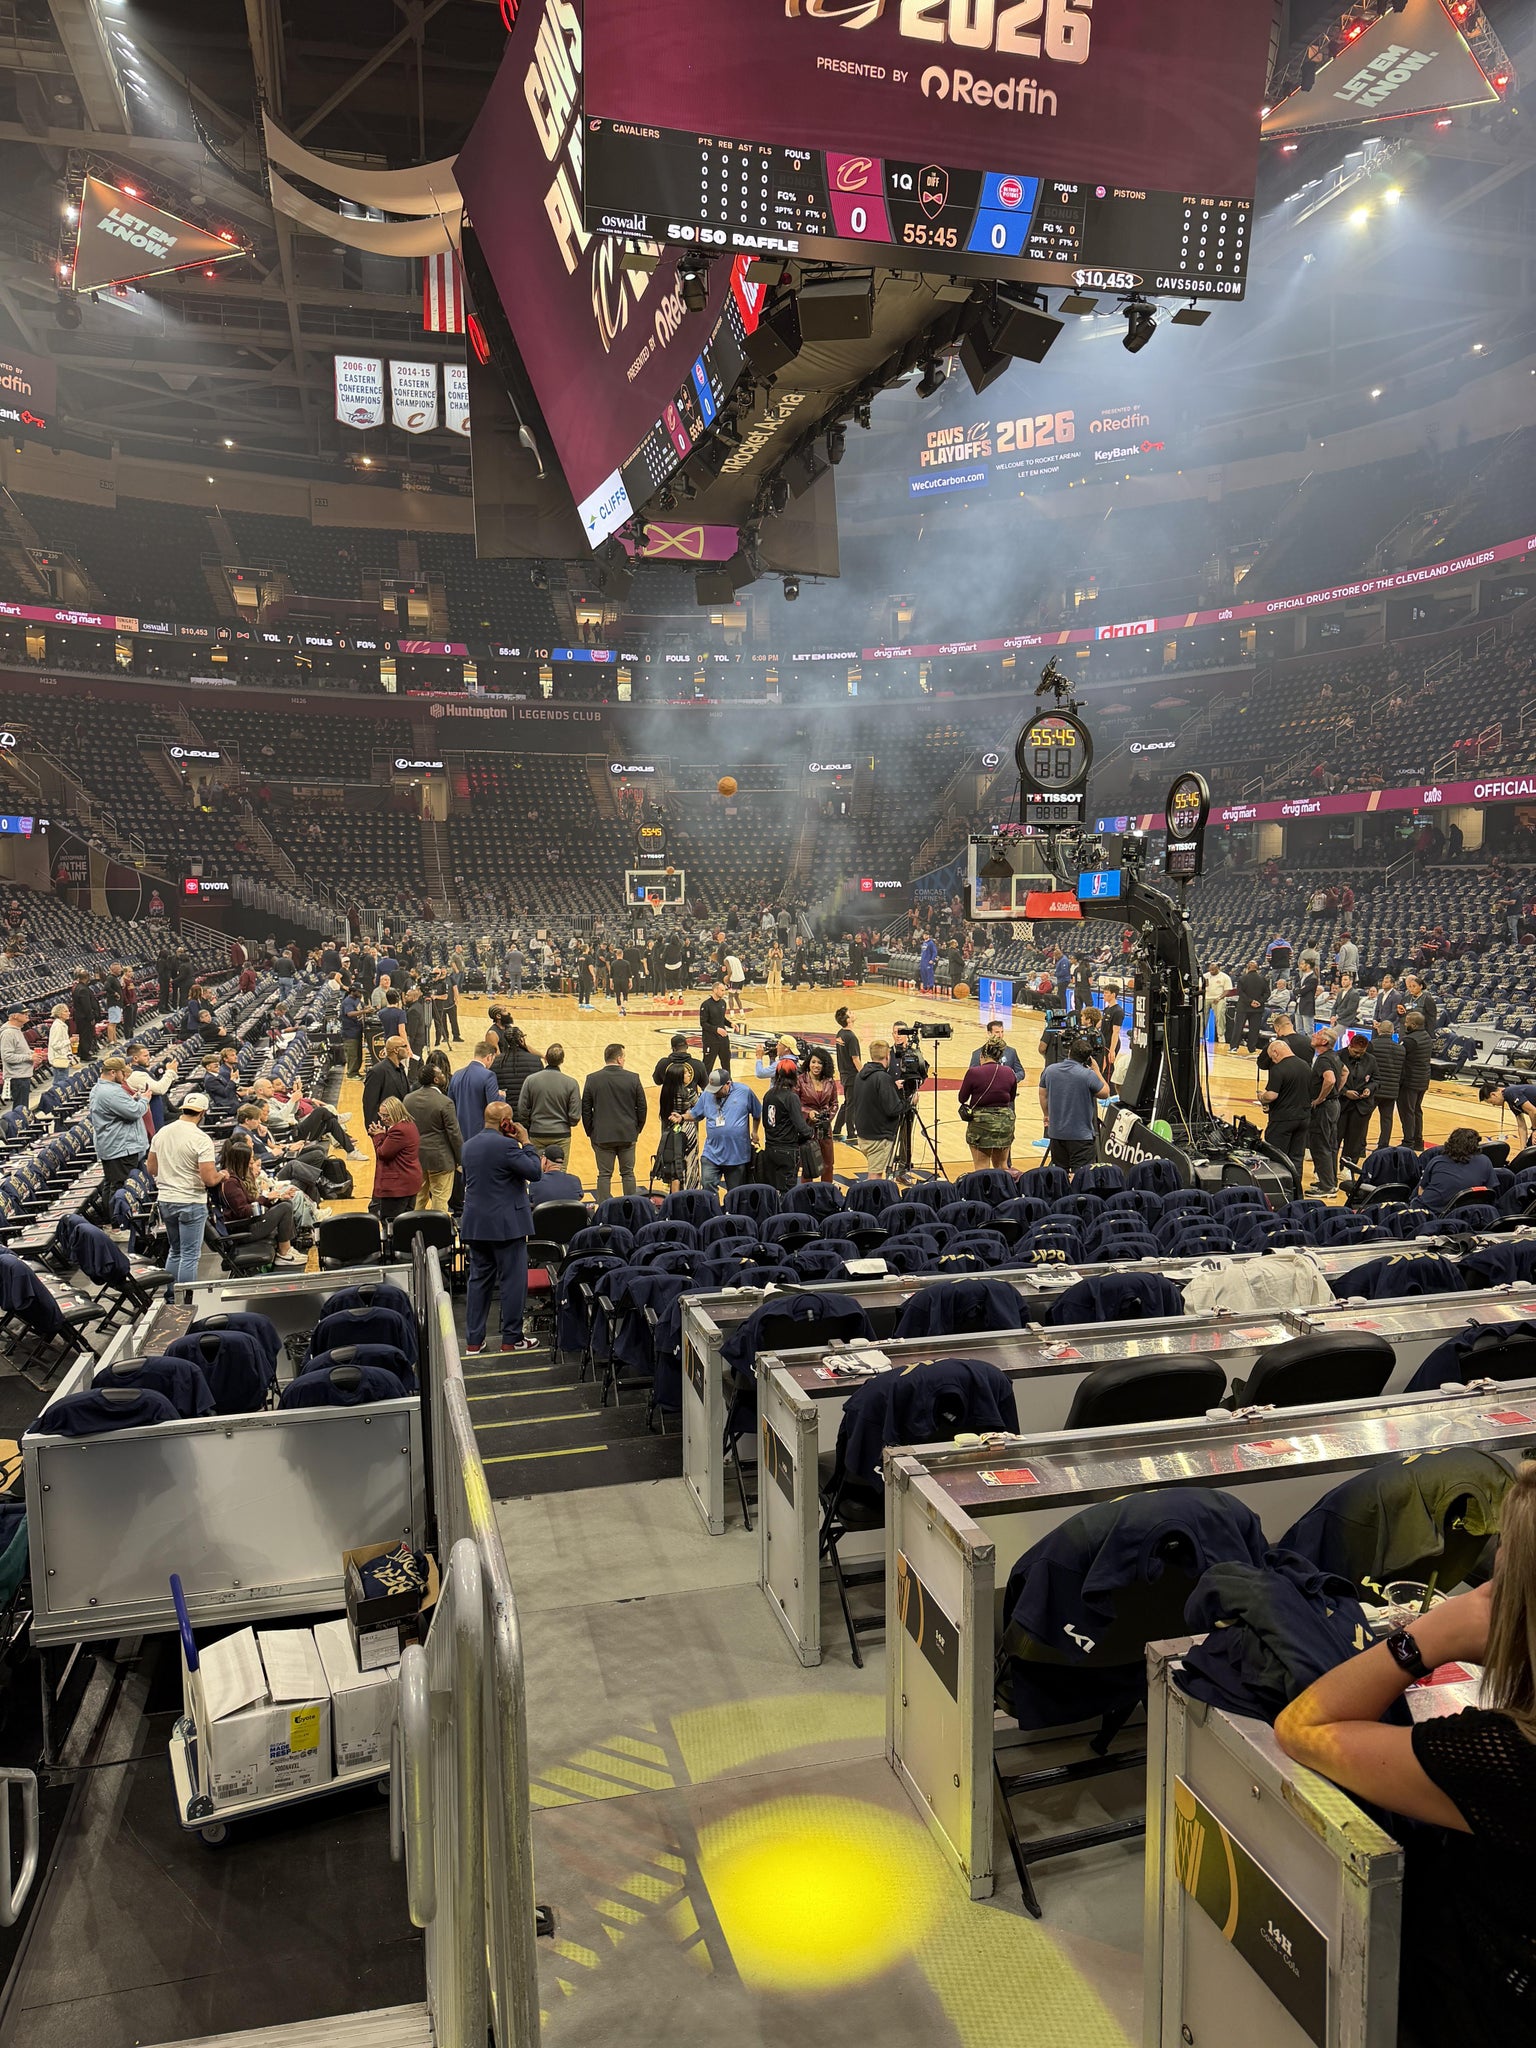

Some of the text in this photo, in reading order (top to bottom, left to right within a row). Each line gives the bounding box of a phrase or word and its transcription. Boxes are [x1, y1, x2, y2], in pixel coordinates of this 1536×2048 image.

[816, 57, 909, 84] PRESENTED BY
[1332, 44, 1411, 101] LET EM
[1354, 50, 1440, 109] KNOW.
[952, 69, 1058, 117] Redfin
[612, 124, 660, 139] CAVALIERS
[698, 137, 772, 156] PTS REB AST FLS
[784, 149, 811, 161] FOULS
[794, 159, 800, 171] 0
[891, 172, 913, 191] 1Q
[1054, 183, 1078, 193] FOULS
[778, 191, 814, 204] FG% 0
[1062, 193, 1068, 204] 0
[1113, 189, 1146, 200] PISTONS
[1182, 196, 1250, 209] PTS REB AST FLS
[774, 206, 820, 219] 3PT% 0 FT%
[601, 214, 647, 232] oswald
[850, 206, 867, 233] 0
[108, 207, 178, 248] LET EM
[776, 220, 819, 234] TOL 7 CH
[1069, 226, 1076, 234] 0
[97, 217, 169, 260] KNOW.
[903, 222, 958, 248] 55:45
[991, 224, 1006, 249] 0
[732, 234, 799, 252] RAFFLE
[1030, 236, 1072, 247] 3PT% FT%
[1029, 249, 1068, 261] TOL 7 CH
[1074, 269, 1134, 289] $10,453
[1156, 276, 1242, 294] CAVS5050.COM
[343, 361, 377, 373] 2006-07
[397, 366, 431, 378] 2014-15
[344, 374, 376, 384] EASTERN
[399, 378, 430, 388] EASTERN
[339, 384, 382, 394] CONFERENCE
[393, 388, 436, 399] CONFERENCE
[341, 393, 381, 405] CHAMPIONS
[396, 398, 434, 409] CHAMPIONS
[1101, 406, 1132, 416] PRESENTED
[1103, 412, 1150, 433] Redfin
[926, 426, 964, 450] CAVS
[996, 410, 1076, 454] 2026
[724, 430, 774, 467] Rocket
[920, 439, 992, 468] PLAYOFFS
[1094, 445, 1140, 461] KeyBank
[996, 452, 1082, 471] WELCOME TO ROCKET ARENA!
[1017, 470, 1028, 478] LET
[911, 471, 985, 492] WeCutCarbon.com
[600, 486, 627, 520] CLIFFS
[1266, 551, 1495, 612] OFFICIAL DRUG STORE OF THE CLEVELAND CAVALIERS
[55, 612, 102, 626] drug mart
[143, 622, 169, 632] oswald
[180, 627, 208, 636] $10,453
[263, 633, 280, 643] TOL
[306, 637, 346, 648] FOULS 0
[1003, 636, 1042, 648] drug mart
[356, 641, 391, 651] FG% 0
[444, 644, 451, 654] 0
[500, 647, 520, 657] 55:45
[939, 643, 977, 654] drug mart
[534, 649, 549, 659] 1Q
[620, 653, 638, 662] FG%
[666, 654, 690, 663] FOULS
[714, 654, 730, 662] TOL
[768, 654, 779, 662] PM
[792, 654, 812, 662] LET
[874, 648, 912, 658] drug mart
[446, 704, 601, 721] Huntington LEGENDS CLUB
[1031, 728, 1076, 746] 55:45
[1142, 741, 1176, 750] LEXUS
[183, 750, 220, 759] LEXUS
[408, 760, 444, 768] LEXUS
[622, 765, 655, 773] LEXUS
[820, 762, 852, 771] LEXUS
[1474, 779, 1536, 798] OFFICIAL
[1042, 794, 1084, 802] TISSOT
[1176, 792, 1200, 809] 55:45
[1282, 800, 1321, 816] drug mart
[1222, 807, 1256, 822] drug mart
[2, 819, 8, 830] 0
[1176, 842, 1197, 850] TISSOT
[70, 862, 87, 870] THE
[200, 882, 229, 890] TOYOTA
[874, 881, 902, 889] TOYOTA
[914, 888, 946, 896] COMCAST
[1136, 1012, 1146, 1028] THE
[270, 1744, 290, 1753] MADE
[1268, 1920, 1293, 1957] 14H
